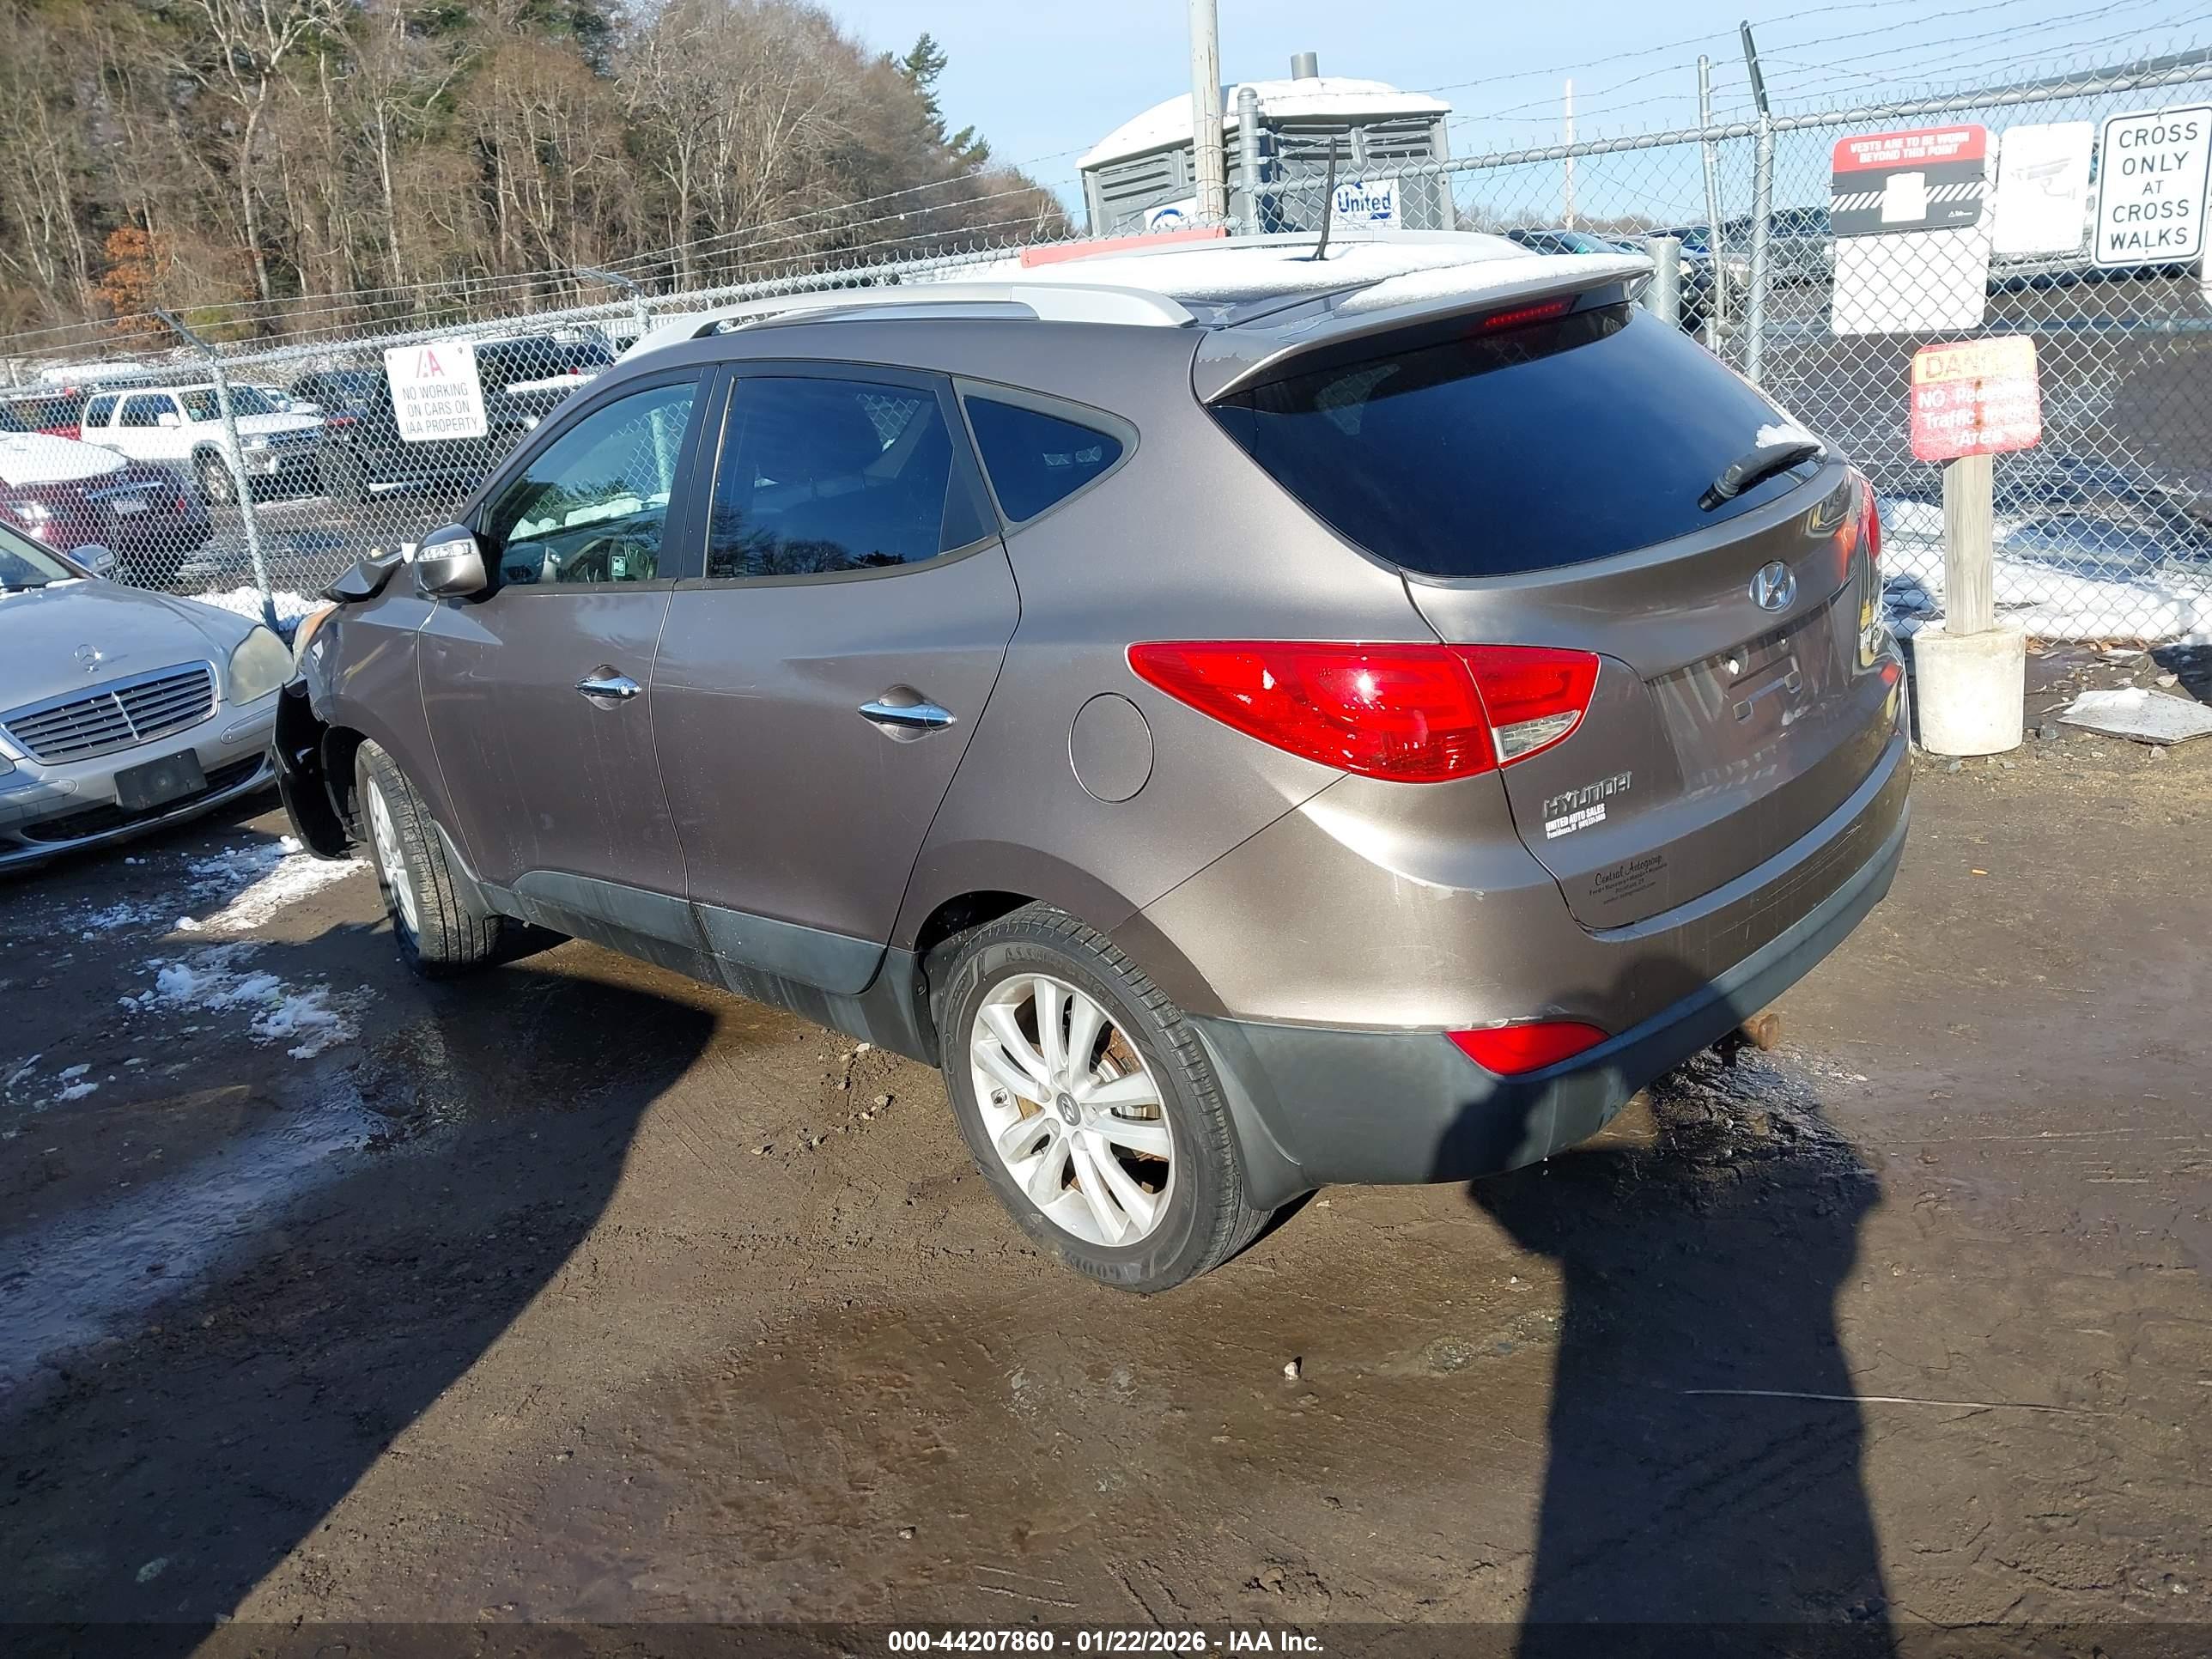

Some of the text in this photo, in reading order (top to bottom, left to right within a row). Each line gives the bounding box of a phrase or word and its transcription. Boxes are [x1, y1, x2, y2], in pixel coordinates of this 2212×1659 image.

[1850, 140, 1882, 154] VESTS
[1884, 138, 1904, 149] ARE
[1906, 137, 1919, 148] TO
[1922, 134, 1936, 146] BE
[2119, 122, 2198, 149] CROSS
[1859, 143, 1960, 163] BEYOND THIS POINT
[2123, 151, 2190, 176] ONLY
[2142, 179, 2165, 196] AT
[1337, 190, 1392, 213] United
[2112, 199, 2189, 223] CROSS
[2110, 227, 2188, 250] WALKS
[402, 382, 469, 401] NO WORKING
[1918, 388, 1947, 410] NO
[407, 399, 471, 418] ON CARS ON
[1922, 408, 1975, 430] Traffic
[405, 416, 478, 434] IAA PROPERTY
[1546, 803, 1606, 832] UNITED AUTO SALES
[1595, 866, 1624, 886] Central
